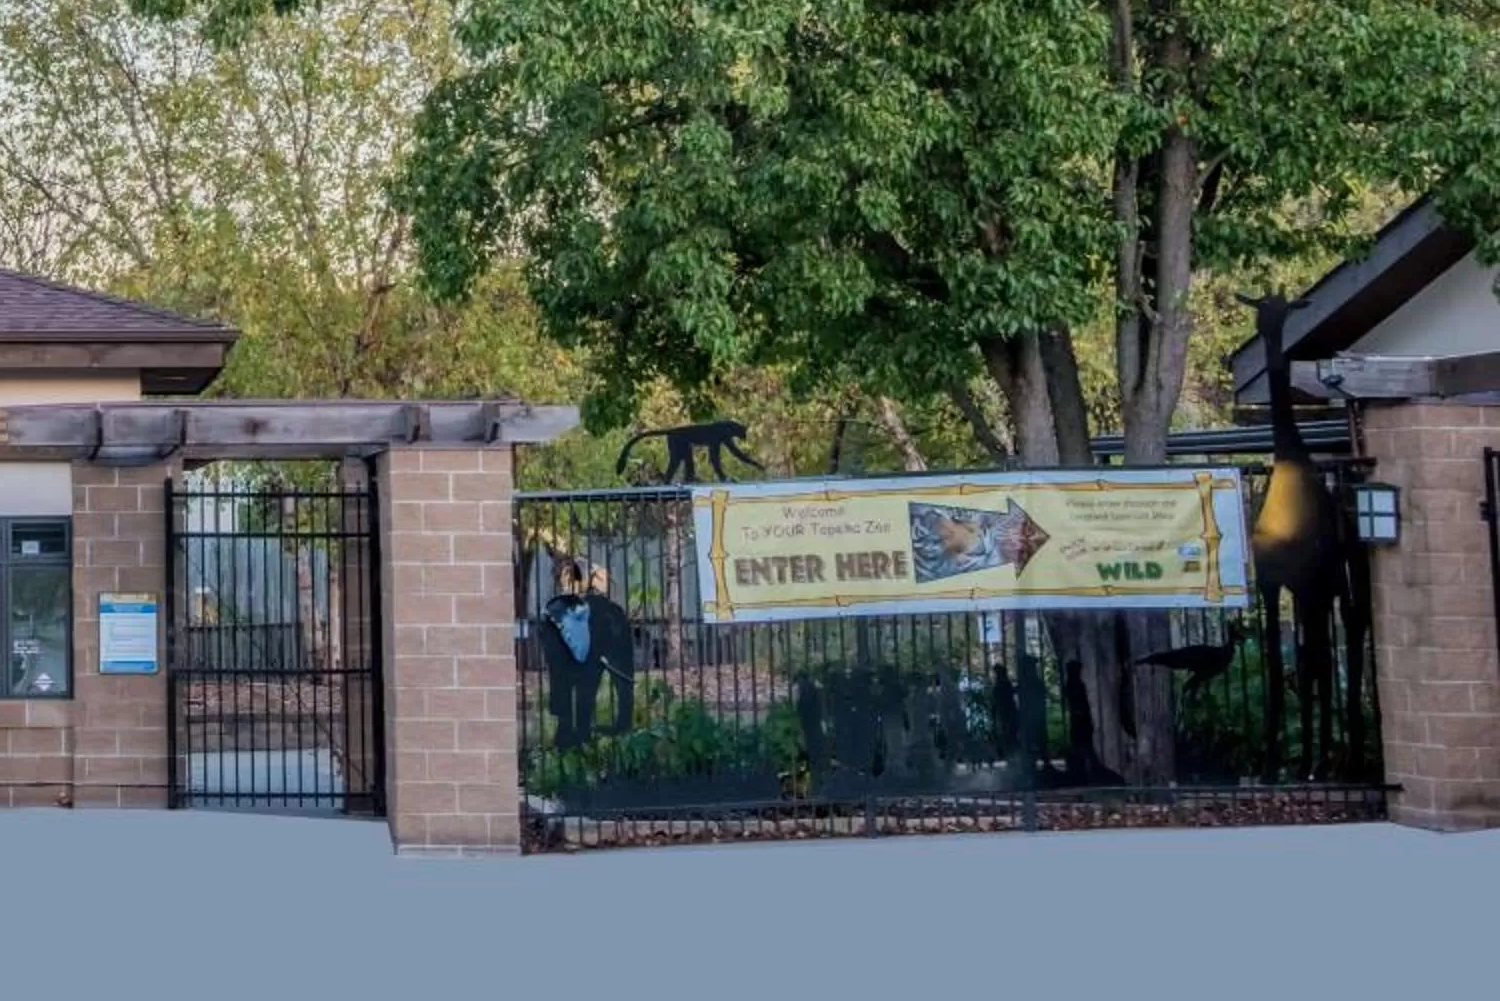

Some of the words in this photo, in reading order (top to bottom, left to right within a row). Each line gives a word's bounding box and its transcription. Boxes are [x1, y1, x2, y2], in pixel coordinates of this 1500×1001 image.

[782, 506, 845, 519] Welcome
[742, 526, 758, 541] To
[764, 524, 804, 538] YOUR
[734, 554, 825, 585] ENTER
[835, 550, 910, 581] HERE
[1096, 561, 1164, 581] WILD
